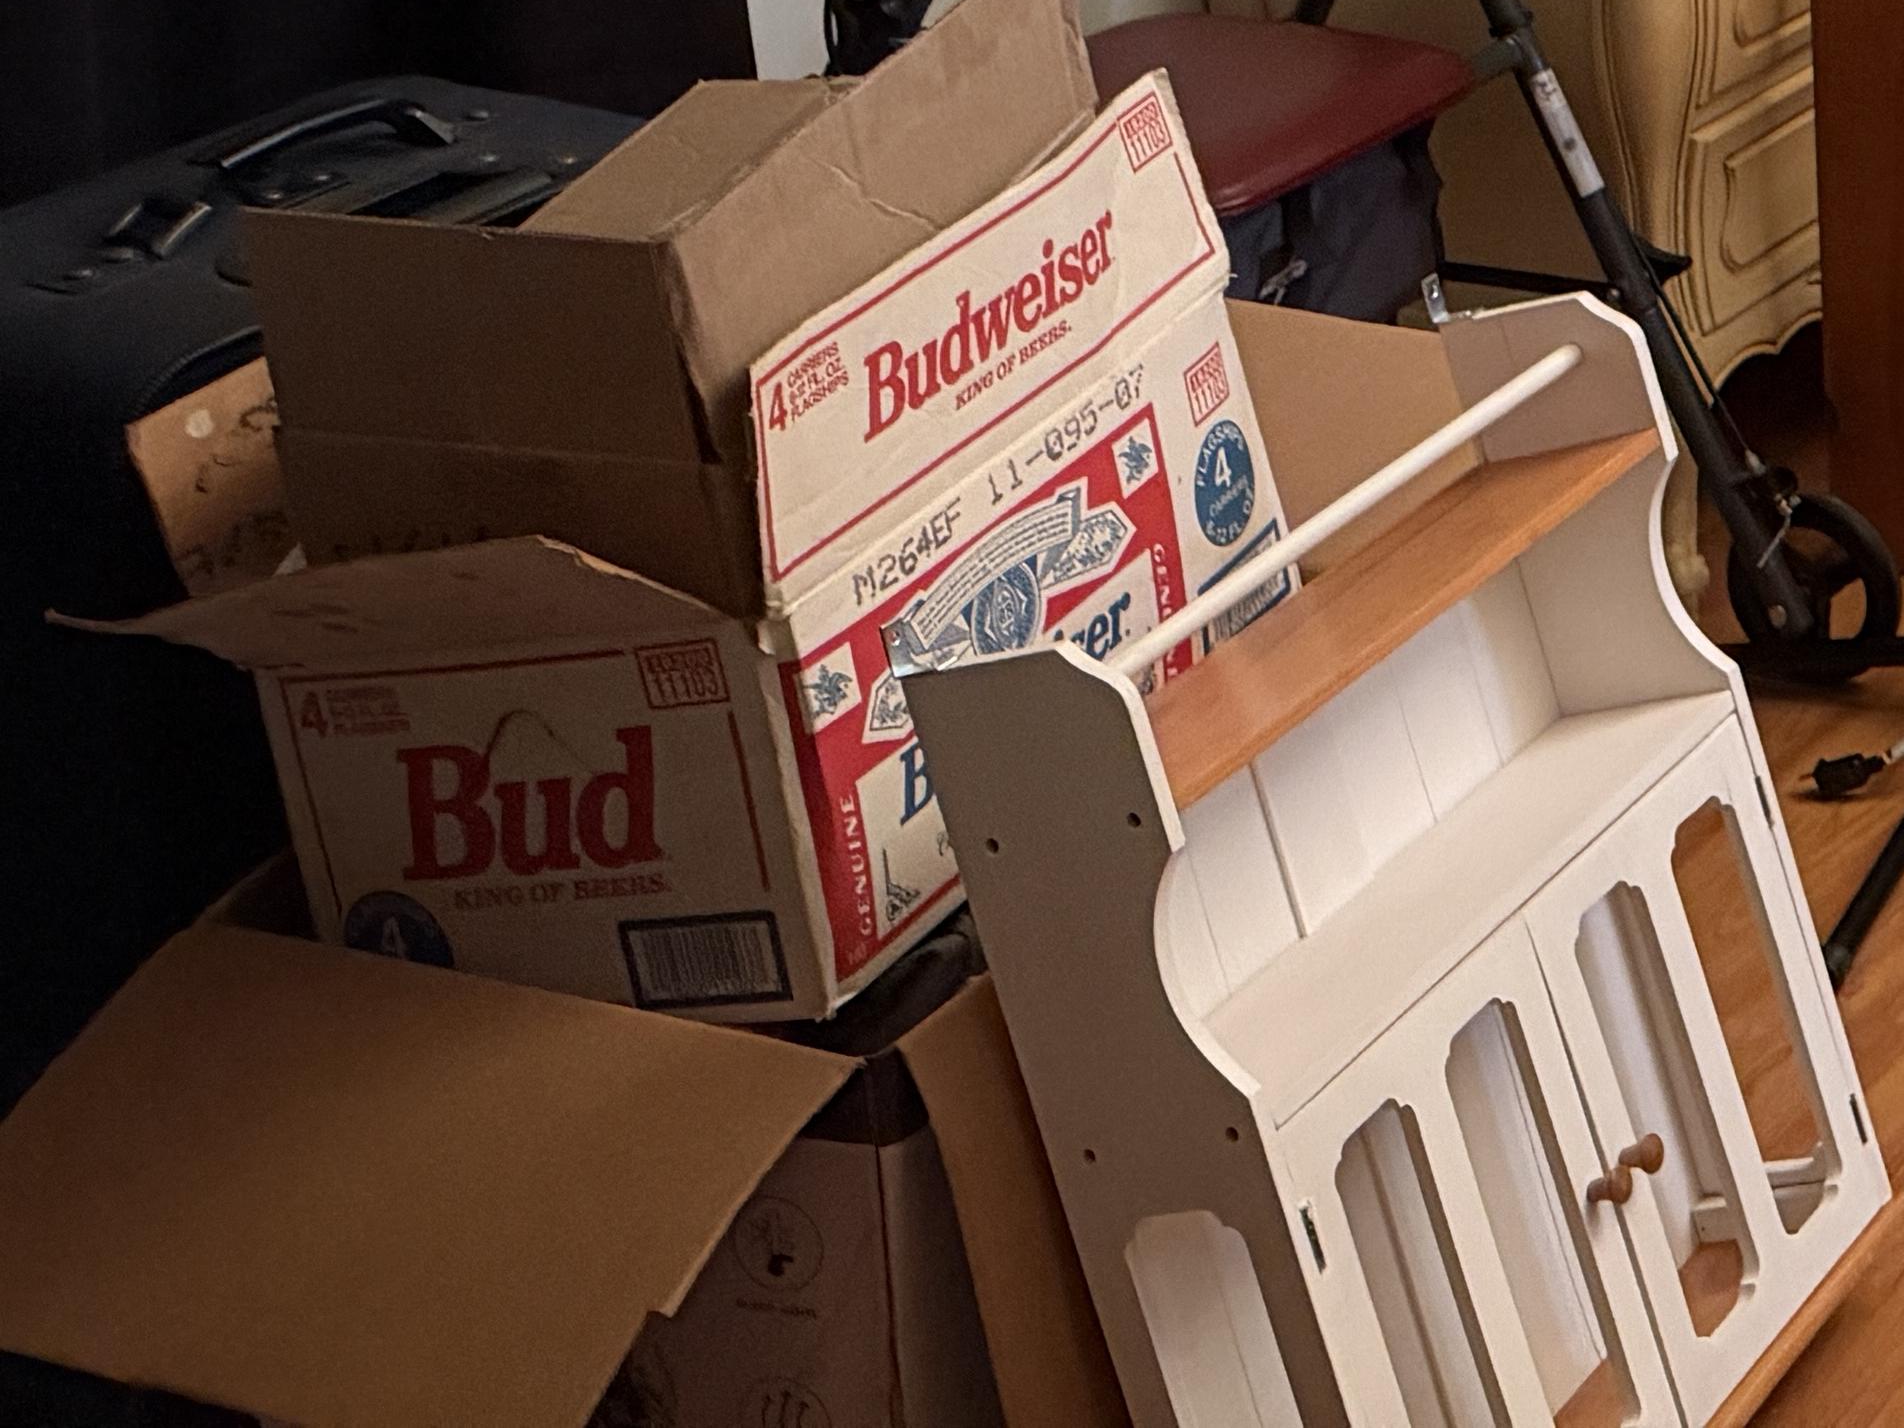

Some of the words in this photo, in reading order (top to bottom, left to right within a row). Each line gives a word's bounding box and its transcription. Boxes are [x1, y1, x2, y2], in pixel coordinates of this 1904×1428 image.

[863, 209, 1113, 443] Budweiser
[769, 381, 788, 431] 4
[955, 371, 994, 411] KING
[996, 353, 1016, 380] OF
[1214, 446, 1232, 487] 4
[852, 496, 961, 606] M264EF
[301, 691, 328, 737] 4
[397, 725, 665, 881] Bud
[840, 794, 872, 935] GENUINE
[454, 886, 524, 908] KING
[532, 882, 564, 903] OF
